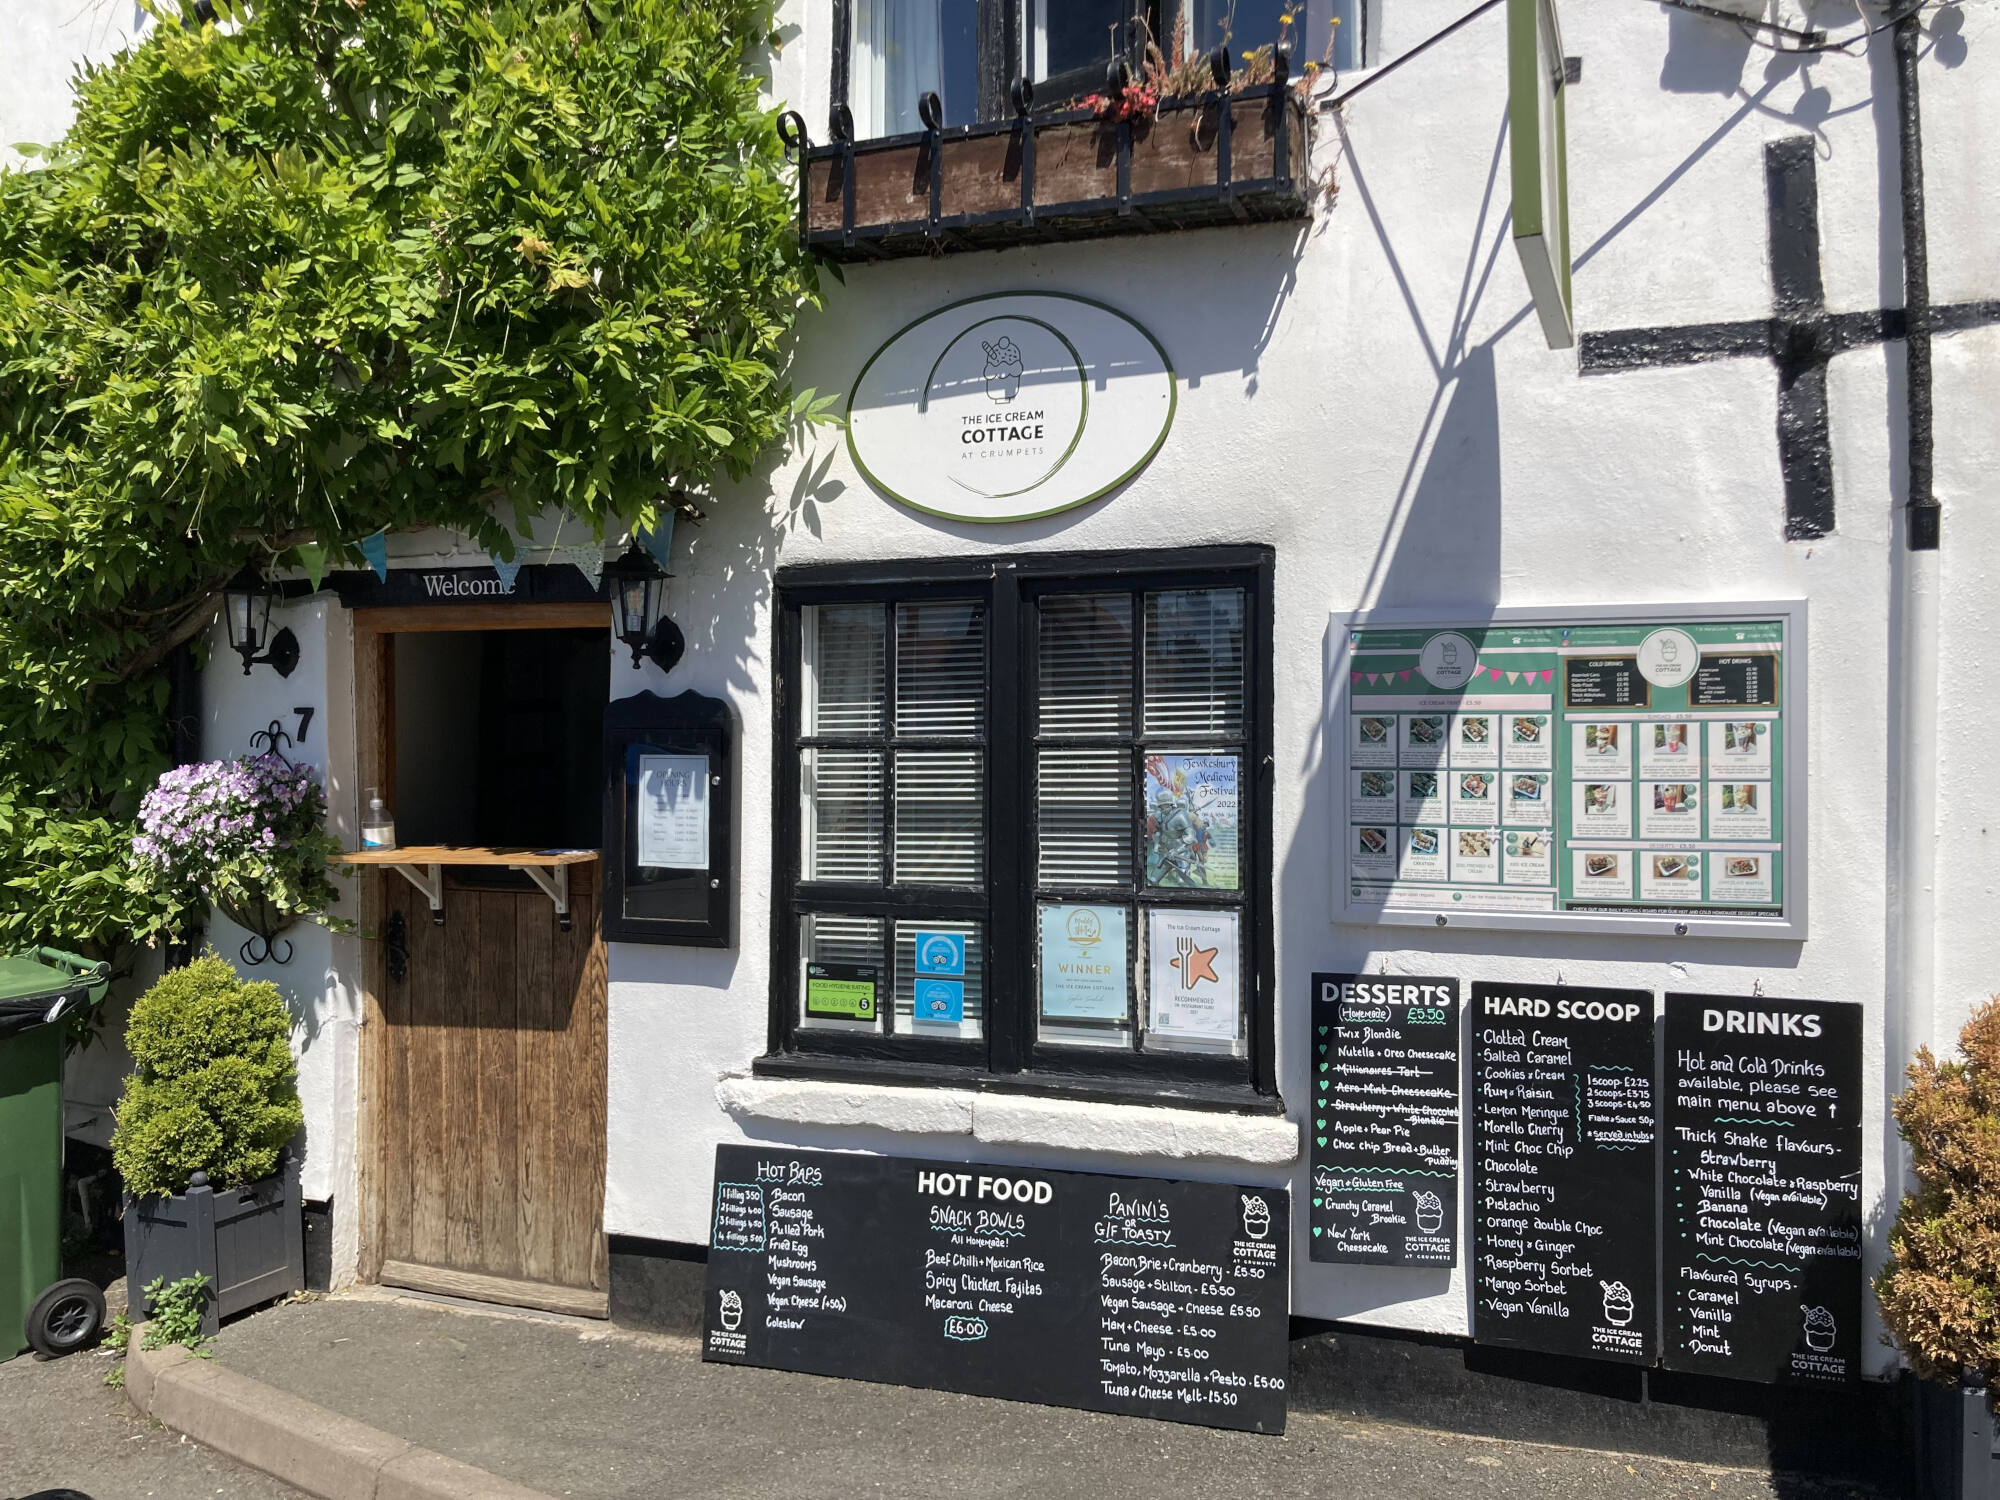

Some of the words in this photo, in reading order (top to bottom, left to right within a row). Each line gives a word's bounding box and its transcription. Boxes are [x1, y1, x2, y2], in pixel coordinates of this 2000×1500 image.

[962, 415, 982, 424] THE
[986, 414, 1002, 423] ICE
[1005, 410, 1044, 421] CREAM
[962, 425, 1044, 444] COTTAGE
[962, 452, 973, 460] AT
[981, 448, 1044, 458] CRUMPETS
[294, 707, 314, 742] 7
[1196, 772, 1236, 784] Medieval
[1200, 786, 1236, 797] Festival
[1059, 964, 1111, 975] WINNER
[1175, 996, 1214, 1004] RECOMMENDED
[1322, 983, 1450, 1006] DESSERTS
[861, 1000, 868, 1009] 5
[1484, 997, 1550, 1017] HARD
[1557, 1000, 1640, 1022] SCOOP
[1703, 1009, 1822, 1037] DRINKS
[1333, 1026, 1359, 1039] Twix
[1362, 1027, 1401, 1044] Blondie
[1483, 1029, 1526, 1045] Clotted
[1532, 1030, 1571, 1049] Cream
[1338, 1045, 1374, 1057] Nutella
[1384, 1049, 1404, 1058] Oreo
[1407, 1049, 1456, 1061] Cheesecake
[1484, 1048, 1520, 1062] Salted
[1527, 1051, 1572, 1065] Caramel
[1678, 1050, 1706, 1072] Hot
[1711, 1055, 1734, 1072] and
[1739, 1057, 1768, 1073] Cold
[1771, 1058, 1824, 1078] Drinks
[1750, 1080, 1800, 1095] please
[1808, 1085, 1838, 1098] see
[1484, 1103, 1517, 1116] Lemon
[1522, 1106, 1569, 1125] Meringue
[1678, 1095, 1711, 1108] main
[1718, 1099, 1760, 1112] menu
[1767, 1100, 1816, 1117] above
[1484, 1120, 1524, 1135] Morello
[1528, 1123, 1563, 1144] Cherry
[1486, 1140, 1510, 1153] Mint
[1514, 1141, 1542, 1154] Choc
[1547, 1142, 1573, 1158] Chip
[1485, 1158, 1538, 1174] Chocolate
[1700, 1150, 1776, 1175] Strawberry
[758, 1161, 785, 1177] HOT
[787, 1161, 822, 1186] BAPS
[918, 1171, 972, 1196] HOT
[978, 1176, 1052, 1204] FOOD
[1486, 1179, 1554, 1202] Strawberry
[769, 1188, 805, 1209] Bacon
[1109, 1193, 1169, 1218] PANINI'S
[1326, 1198, 1359, 1217] Crunchy
[1362, 1200, 1393, 1212] Caramel
[1485, 1197, 1540, 1212] Pistachio
[1696, 1200, 1748, 1214] Banana
[772, 1205, 813, 1225] Sausage
[929, 1206, 971, 1226] SNACK
[975, 1210, 1025, 1233] BOWLS
[1125, 1219, 1136, 1227] OR
[1369, 1214, 1407, 1225] Brookie
[770, 1221, 800, 1236] Pulled
[803, 1224, 824, 1238] Pork
[1095, 1222, 1118, 1239] G/F
[1122, 1228, 1171, 1242] TOASTY
[1327, 1224, 1347, 1238] New
[1350, 1227, 1370, 1241] York
[770, 1238, 790, 1250] Fried
[792, 1241, 808, 1257] Egg
[951, 1234, 963, 1244] All
[1338, 1242, 1388, 1253] Cheesecake
[1233, 1248, 1276, 1259] COTTAGE
[768, 1256, 816, 1271] Mushrooms
[1485, 1255, 1545, 1280] Raspberry
[1551, 1262, 1593, 1277] Sorbet
[768, 1273, 791, 1290] Vegan
[793, 1275, 826, 1293] Sausage
[926, 1271, 956, 1294] Spicy
[962, 1274, 1002, 1292] Chicken
[1005, 1278, 1042, 1298] Fajitas
[1486, 1277, 1521, 1295] Mango
[1525, 1280, 1567, 1295] Sorbet
[767, 1293, 789, 1310] Vegan
[791, 1296, 819, 1308] Cheese
[821, 1295, 846, 1312] (+50p)
[925, 1294, 973, 1310] Macaroni
[979, 1299, 1013, 1313] Cheese
[1101, 1295, 1128, 1314] Vegan
[1132, 1298, 1176, 1317] Sausage
[1186, 1303, 1224, 1316] Cheese
[1688, 1289, 1739, 1305] Caramel
[1485, 1298, 1523, 1318] Vegan
[1526, 1298, 1569, 1317] Vanilla
[1690, 1307, 1732, 1322] Vanilla
[766, 1316, 805, 1329] Coleslaw
[950, 1319, 983, 1334] £6.00
[1592, 1334, 1642, 1348] COTTAGE
[1618, 1329, 1642, 1337] CREAM
[1692, 1326, 1720, 1338] Mint
[1101, 1338, 1130, 1352] Tuna
[1137, 1342, 1165, 1362] Mayo
[1605, 1347, 1643, 1355] CRUMPETS
[1689, 1339, 1732, 1356] Donut
